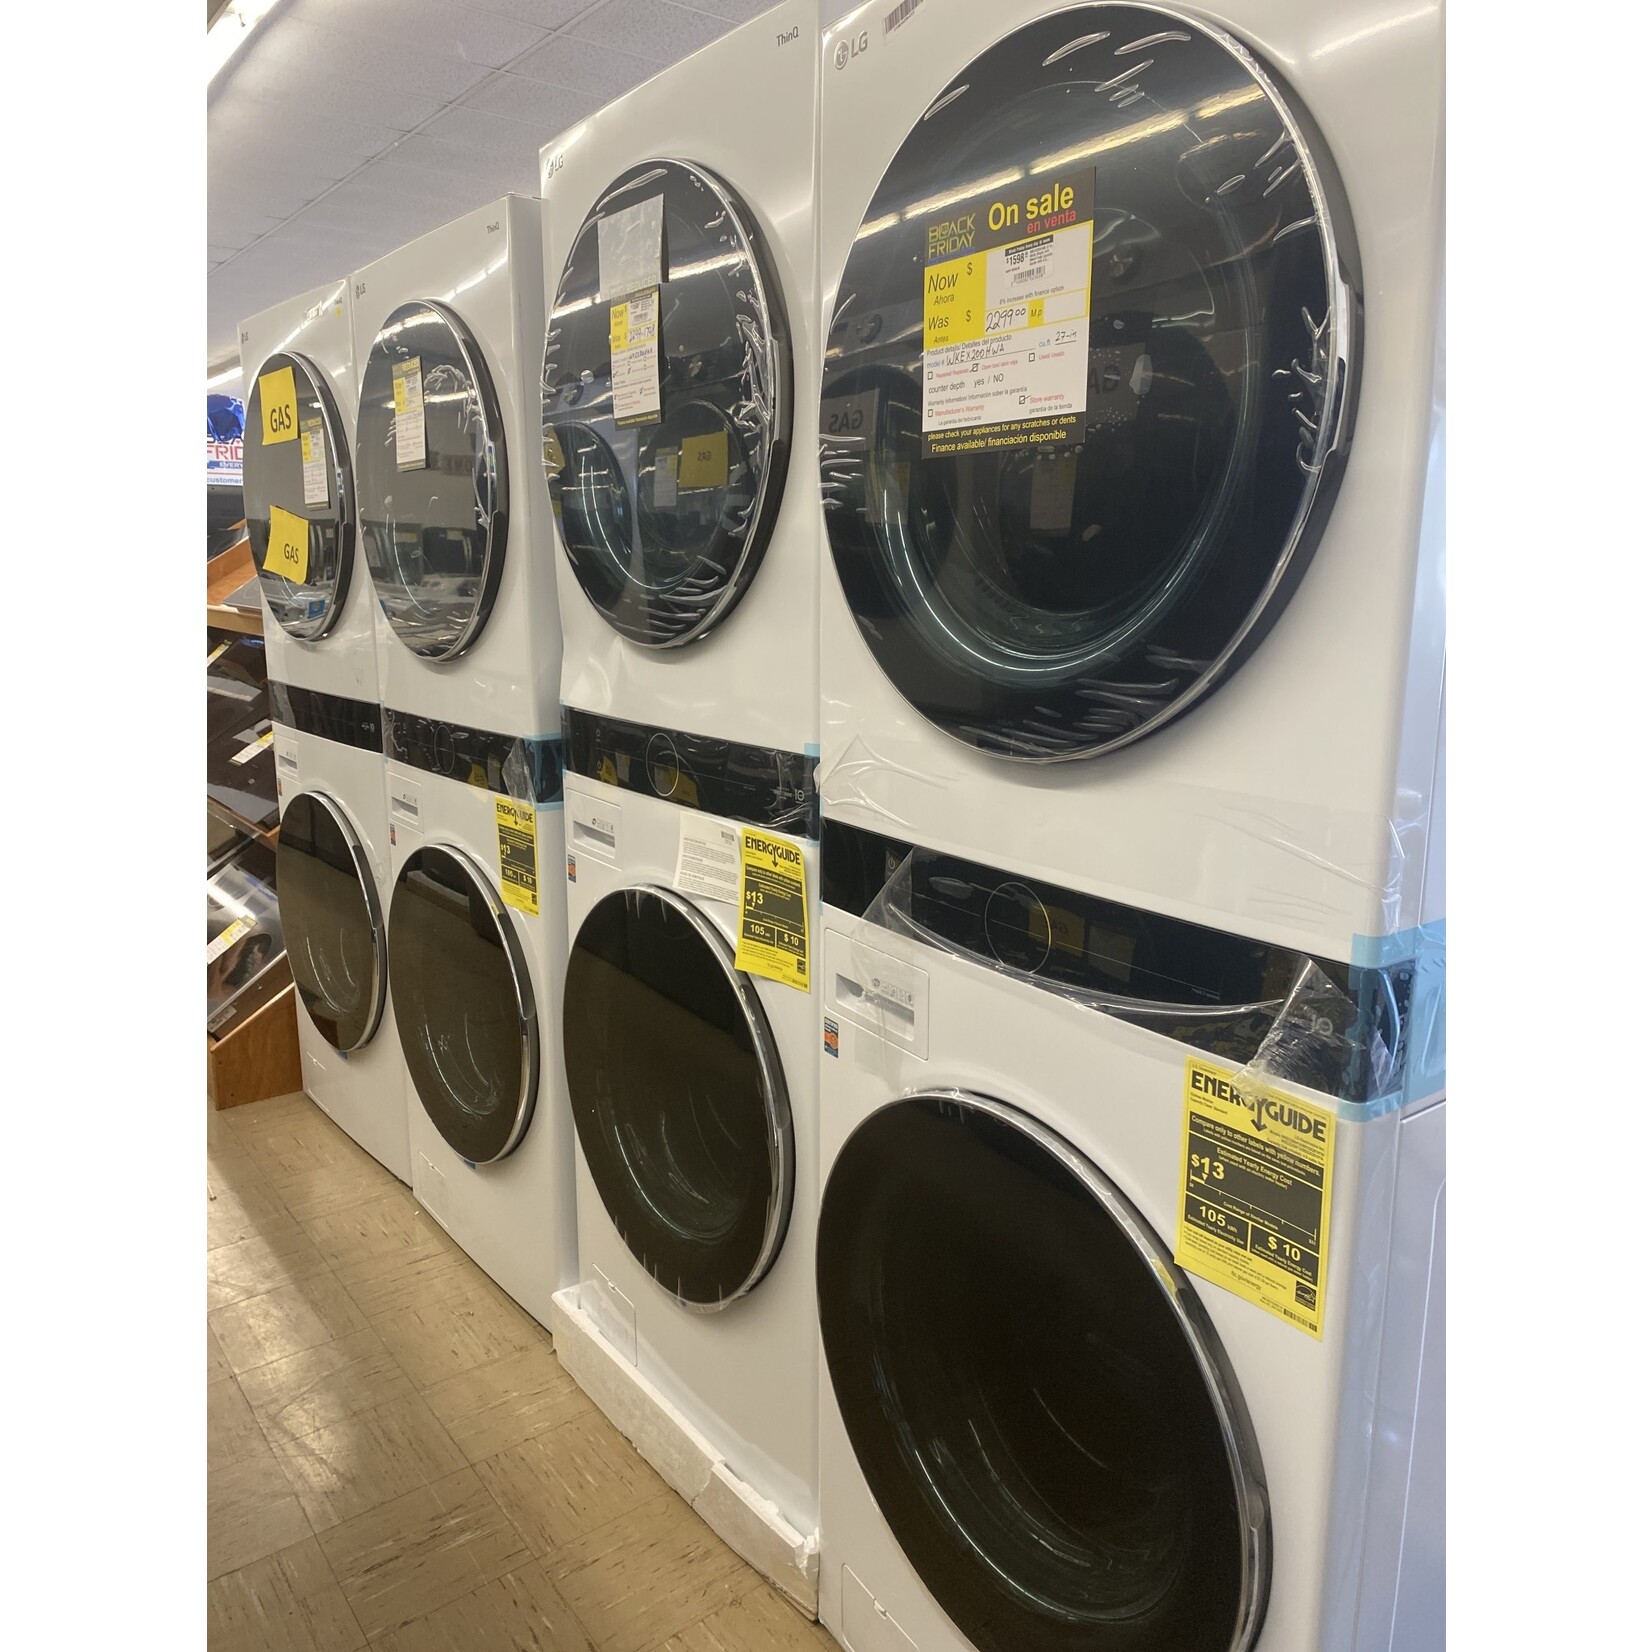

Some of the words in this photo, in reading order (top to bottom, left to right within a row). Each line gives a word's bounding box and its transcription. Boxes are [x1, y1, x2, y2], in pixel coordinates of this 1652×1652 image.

[776, 26, 799, 47] ThinQ
[851, 31, 868, 58] LG
[988, 202, 1019, 231] On
[1026, 183, 1074, 220] sale
[1027, 220, 1040, 234] en
[1044, 209, 1077, 229] venta
[928, 231, 976, 259] FRIDAY
[927, 272, 959, 294] Now
[966, 262, 973, 276] $
[933, 293, 955, 306] Ahora
[1034, 289, 1050, 298] finance
[1050, 285, 1064, 293] option
[927, 316, 949, 331] Was
[966, 310, 972, 323] $
[926, 348, 944, 356] Product
[982, 339, 990, 347] del
[990, 335, 1012, 346] producto
[933, 335, 949, 344] Antes
[927, 361, 941, 369] model
[928, 383, 949, 394] counter
[949, 381, 965, 391] depth
[974, 378, 985, 388] yes
[993, 373, 1004, 383] NO
[1030, 396, 1043, 404] Store
[1043, 394, 1065, 403] warranty
[1058, 402, 1073, 410] tienda
[270, 405, 292, 433] GAS
[928, 433, 944, 441] please
[945, 430, 960, 438] check
[961, 429, 972, 437] your
[973, 424, 1001, 436] appliances
[1001, 423, 1010, 431] for
[1010, 422, 1021, 431] any
[1022, 419, 1051, 429] scratches
[1059, 415, 1077, 424] dents
[931, 444, 956, 453] Finance
[957, 438, 986, 450] available/
[987, 435, 1028, 447] financiación
[1029, 430, 1067, 443] disponible
[284, 543, 299, 564] GAS
[745, 836, 801, 866] ENERGYGUIDE
[746, 890, 764, 905] $13
[750, 924, 765, 935] 105
[784, 933, 789, 943] $
[791, 936, 799, 946] 10
[1191, 1114, 1214, 1130] Compare
[1214, 1124, 1226, 1136] only
[1227, 1129, 1232, 1137] to
[1233, 1132, 1247, 1143] other
[1248, 1137, 1263, 1150] labels
[1264, 1145, 1276, 1156] with
[1276, 1151, 1294, 1165] yellow
[1294, 1159, 1320, 1176] numbers.
[1191, 1154, 1225, 1180] $13
[1216, 1146, 1242, 1163] Estimated
[1242, 1158, 1259, 1171] Yearly
[1260, 1165, 1278, 1180] Energy
[1279, 1174, 1292, 1186] Cost
[1199, 1203, 1226, 1228] 105
[1267, 1234, 1277, 1252] $
[1282, 1242, 1301, 1262] 10
